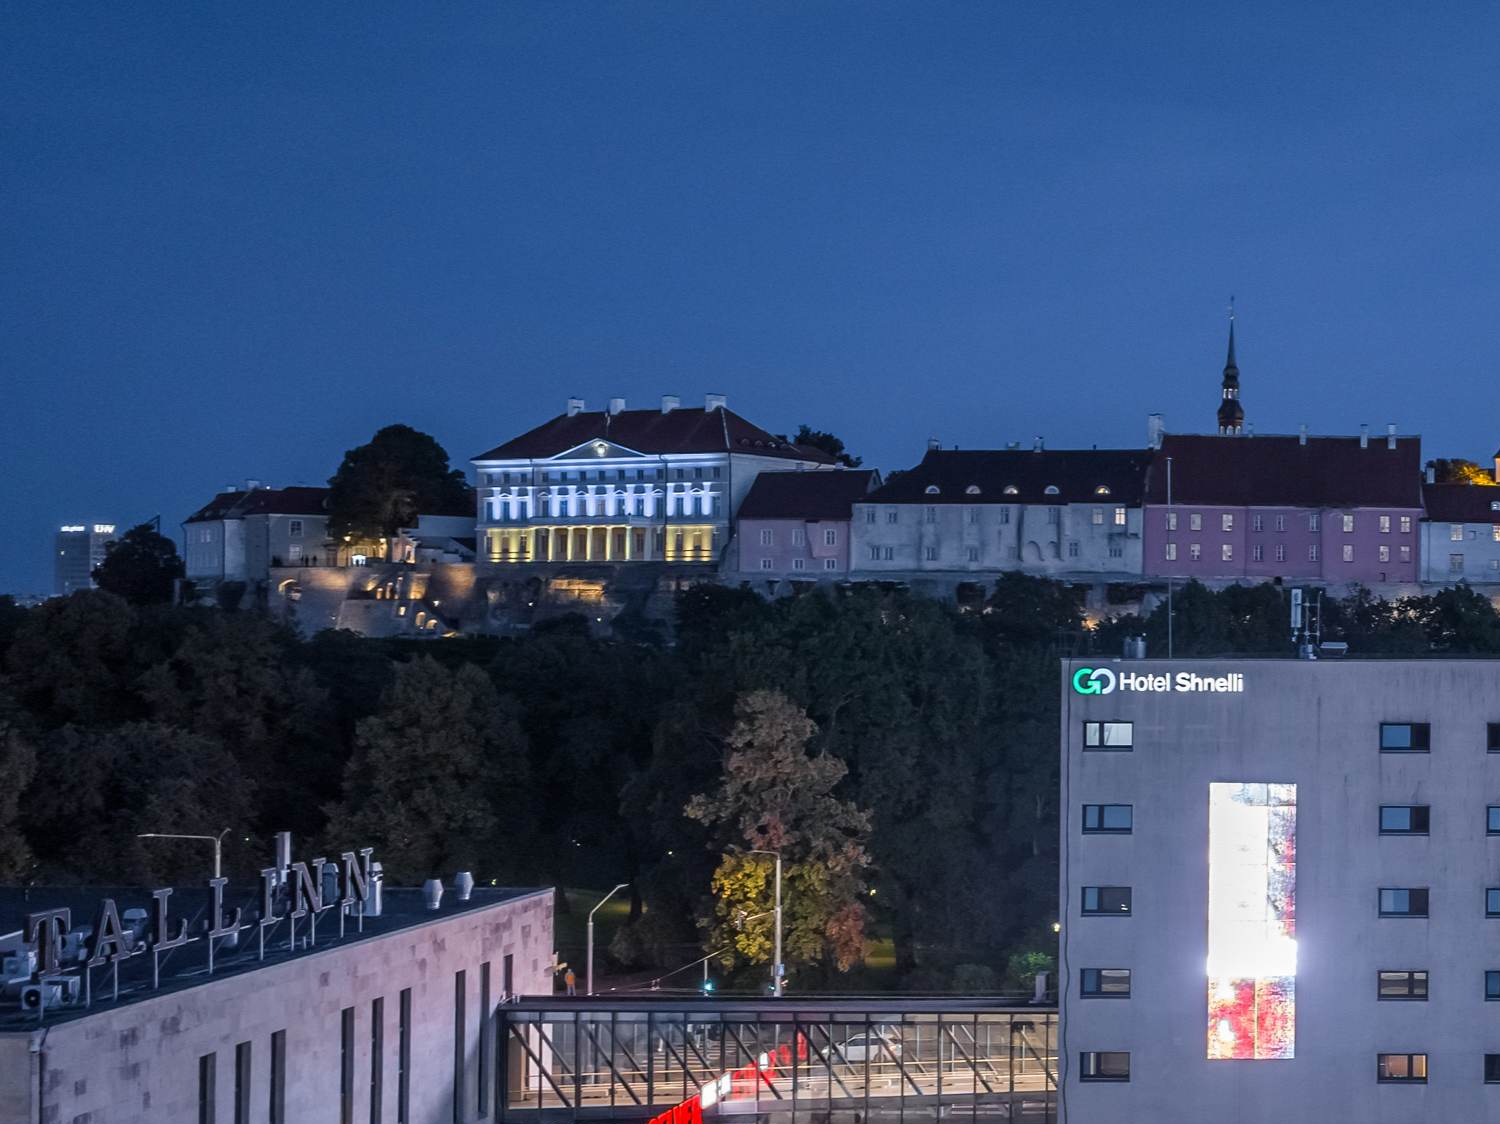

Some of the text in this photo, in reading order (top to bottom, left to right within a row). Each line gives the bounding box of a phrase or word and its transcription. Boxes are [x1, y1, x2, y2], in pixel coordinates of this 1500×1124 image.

[1119, 672, 1170, 692] Hotel
[1175, 671, 1244, 692] Shnelli
[26, 848, 374, 975] TALLINN
